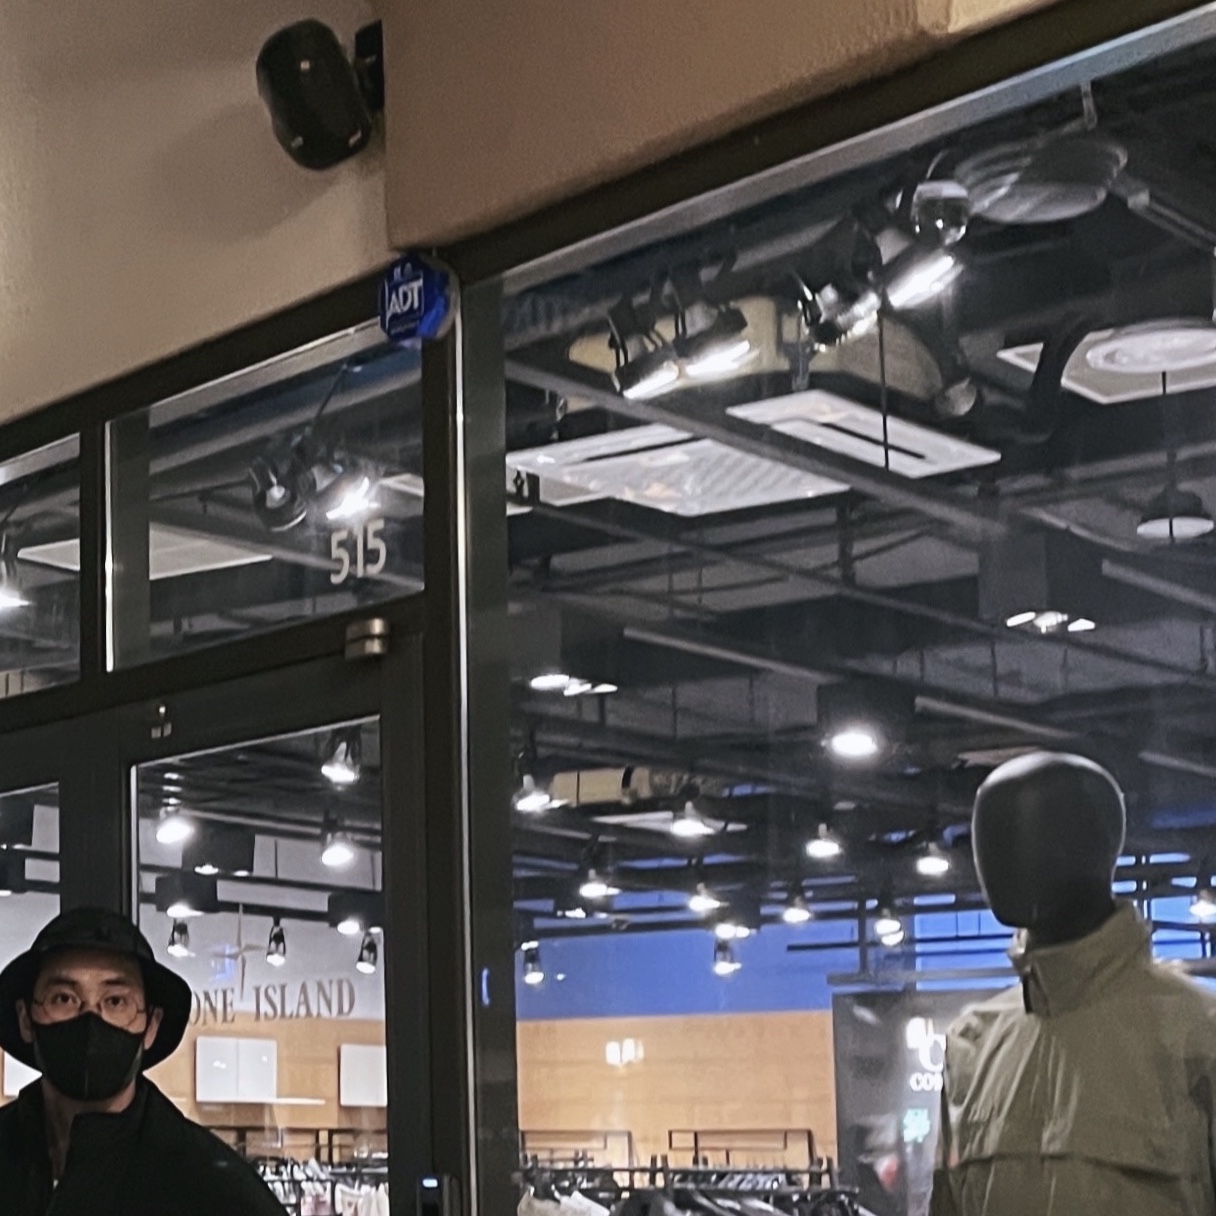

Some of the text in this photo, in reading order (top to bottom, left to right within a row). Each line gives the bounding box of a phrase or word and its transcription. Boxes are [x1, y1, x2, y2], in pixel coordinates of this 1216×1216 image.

[387, 278, 424, 319] ADT
[330, 518, 387, 585] 515
[189, 978, 356, 1026] ONE ISLAND
